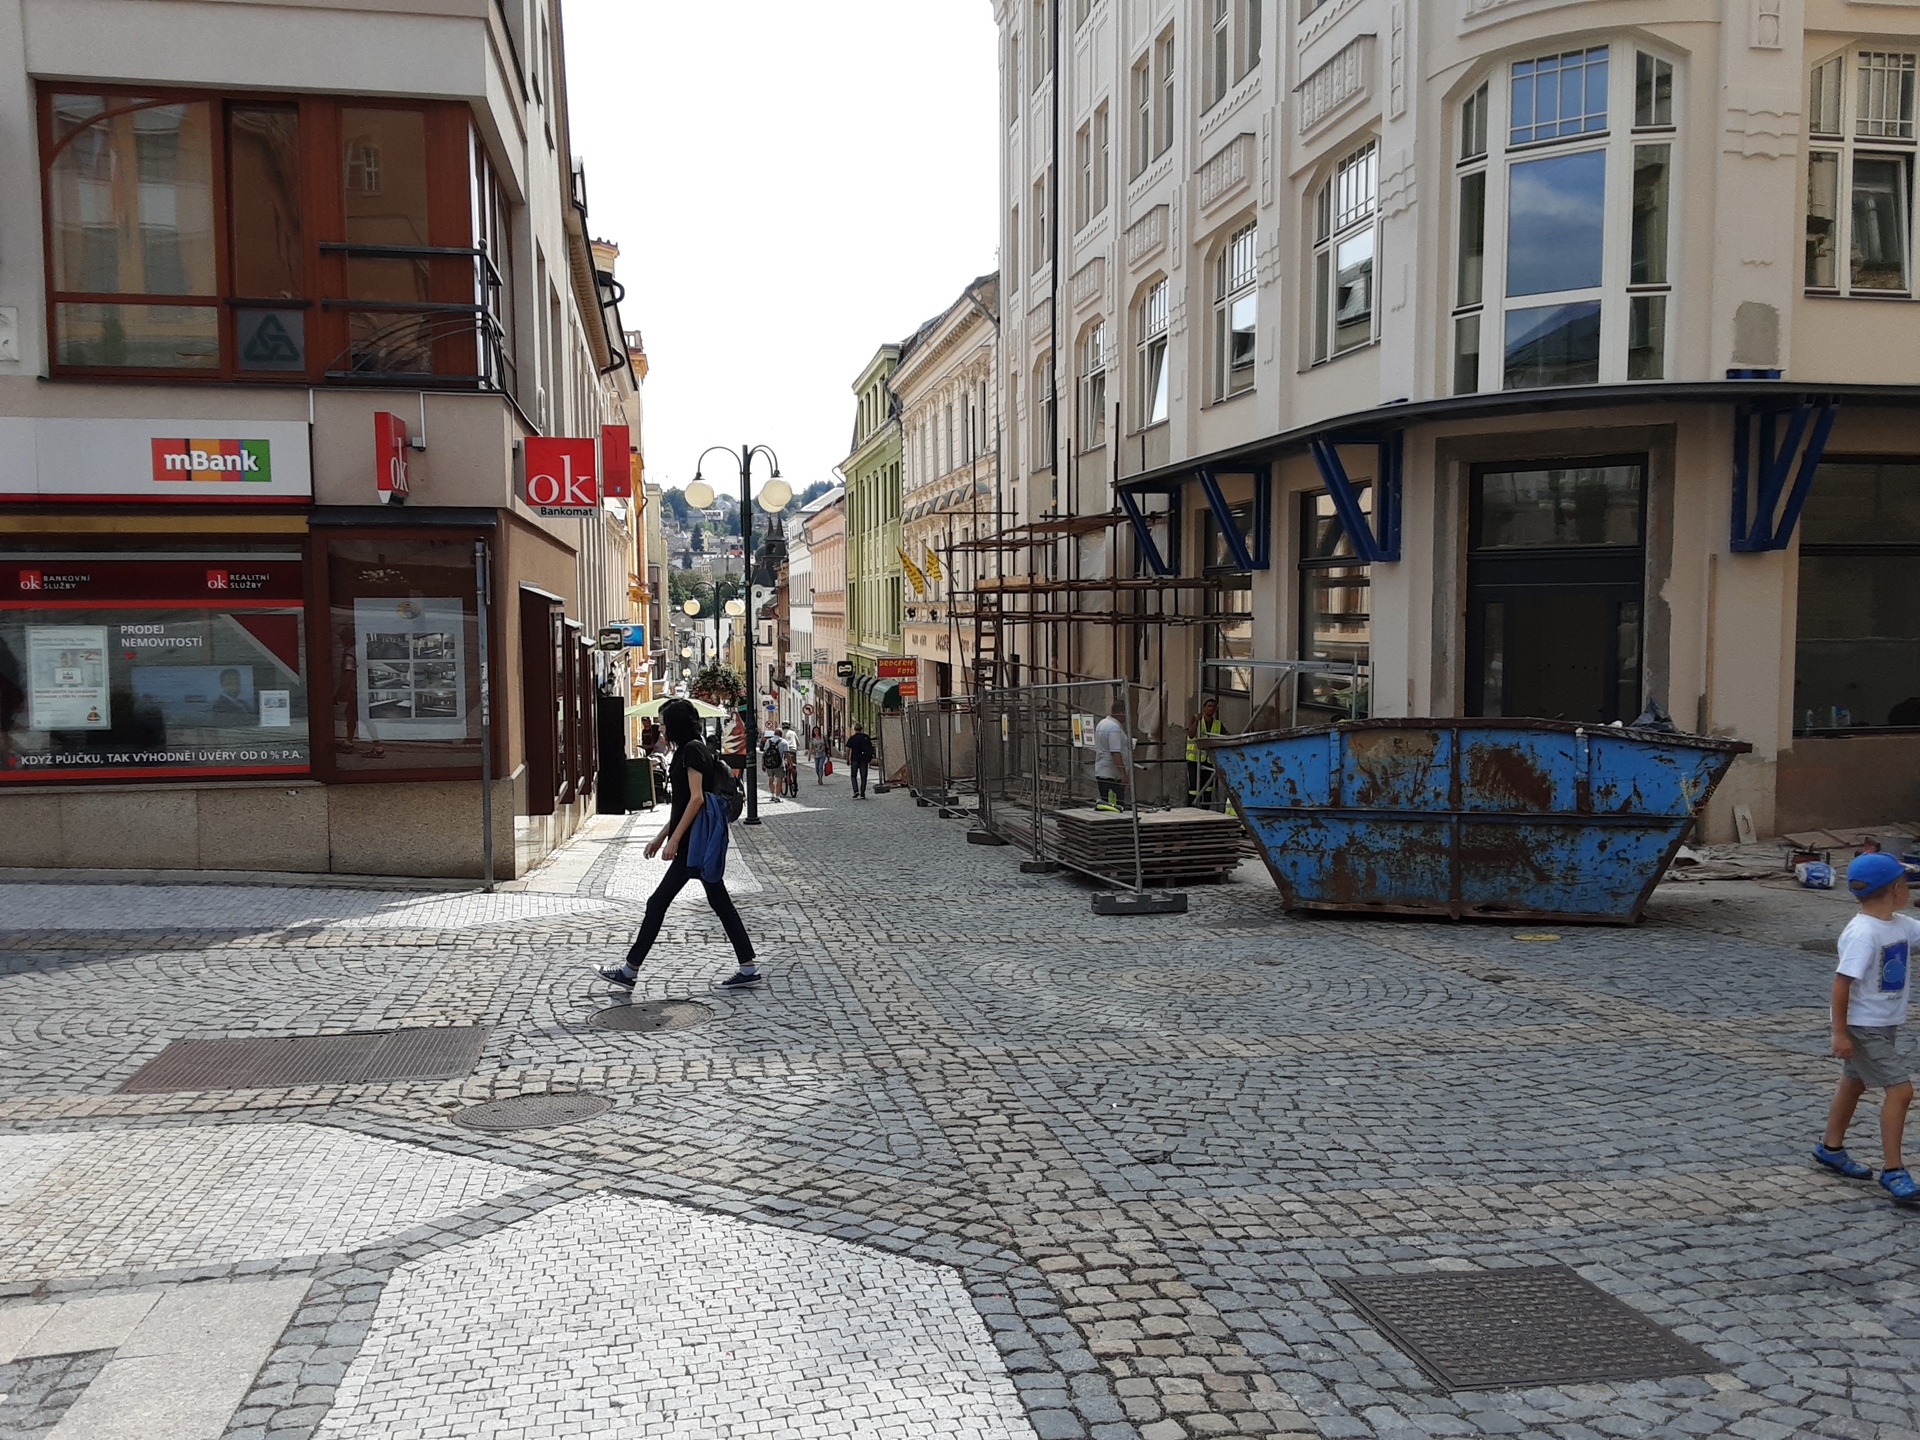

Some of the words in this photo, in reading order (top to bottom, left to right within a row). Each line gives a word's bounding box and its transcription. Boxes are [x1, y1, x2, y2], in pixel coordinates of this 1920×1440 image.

[163, 449, 259, 471] mBank
[390, 436, 409, 492] ok
[528, 455, 594, 504] ok
[540, 507, 593, 516] Bankomat
[20, 575, 41, 590] ok
[43, 574, 90, 582] BANKOVNÍ
[207, 574, 228, 589] ok
[230, 573, 270, 581] REALITNÍ
[43, 582, 76, 590] SLUŽBY
[230, 581, 262, 589] SLUŽBY
[120, 625, 164, 635] PRODEJ
[121, 635, 203, 648] NEMOVITOSTÍ
[21, 754, 52, 765] KDYŽ
[55, 753, 104, 765] PŮJČKU,
[107, 753, 130, 763] TAK
[132, 751, 196, 763] VÝHODNĚ!
[199, 750, 237, 761] ÚVĚRY
[240, 751, 258, 760] OD
[260, 751, 268, 760] 0
[270, 750, 279, 760] %
[282, 750, 304, 760] P.A.
